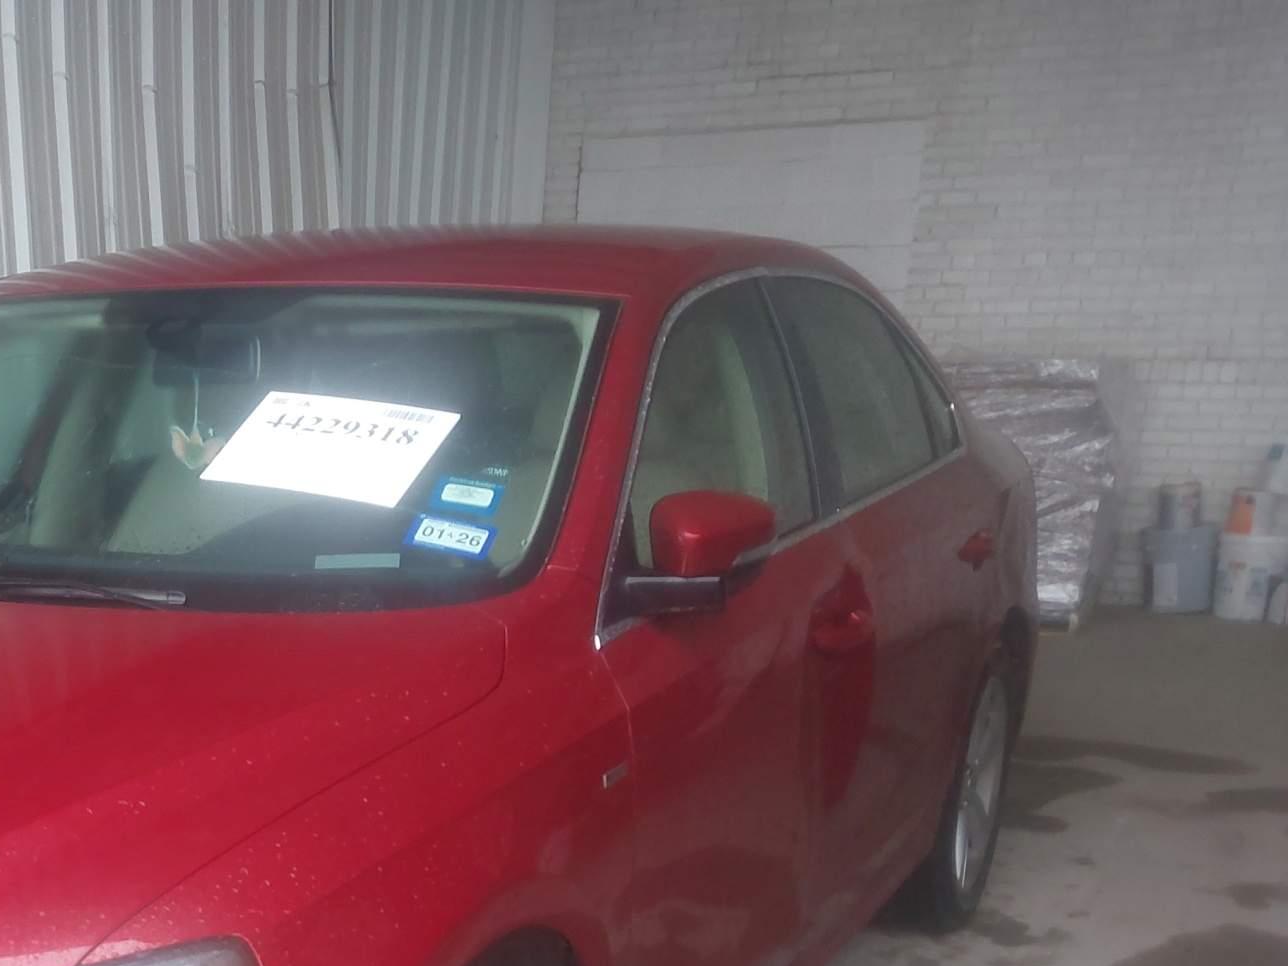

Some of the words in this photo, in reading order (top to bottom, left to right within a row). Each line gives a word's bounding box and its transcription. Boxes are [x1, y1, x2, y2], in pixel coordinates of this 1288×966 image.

[266, 413, 419, 445] 44229318
[422, 526, 445, 539] 01
[456, 533, 482, 547] 26
